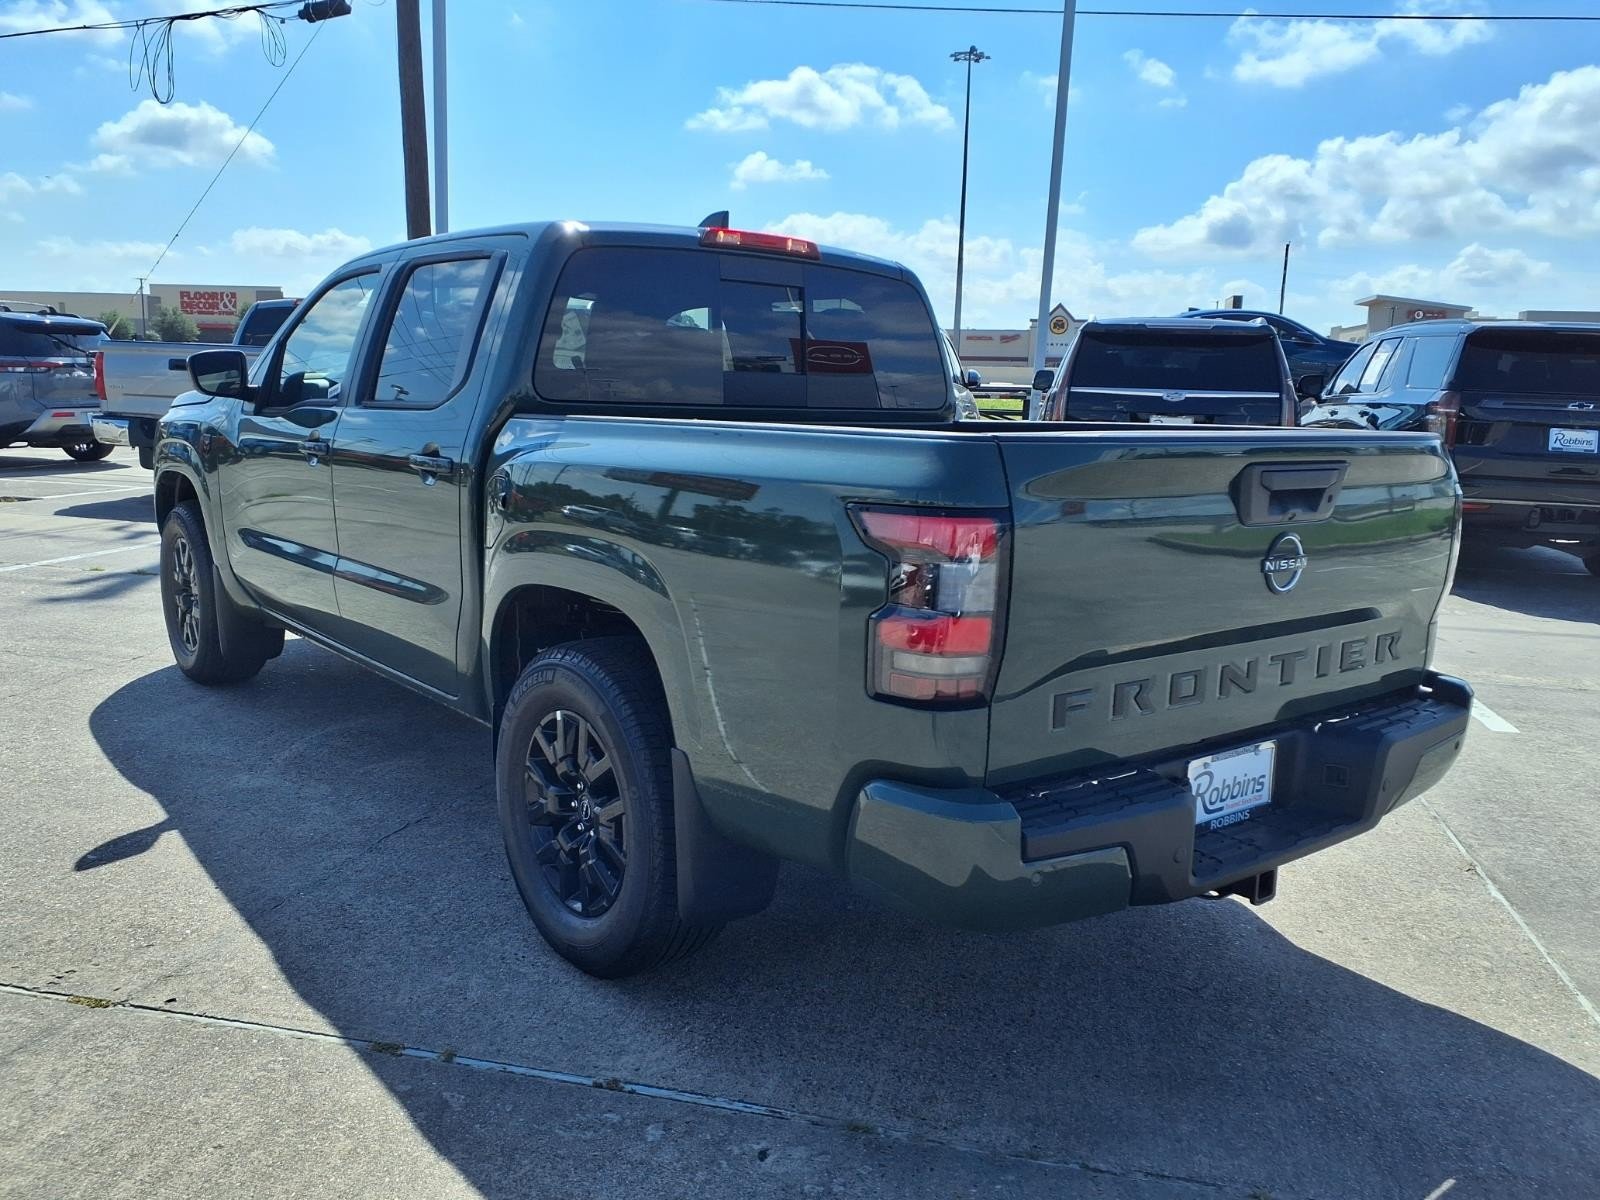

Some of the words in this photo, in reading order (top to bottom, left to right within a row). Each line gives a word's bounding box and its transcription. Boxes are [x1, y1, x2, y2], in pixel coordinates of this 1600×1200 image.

[179, 291, 219, 301] FLOOR
[180, 300, 220, 310] DECOR
[1554, 432, 1594, 447] Robbins
[1265, 558, 1307, 571] NISSAN
[512, 669, 556, 705] MICHELIN
[1050, 631, 1402, 732] FRONTIER
[1194, 770, 1266, 815] Robbins
[1210, 809, 1250, 830] ROBBINS
